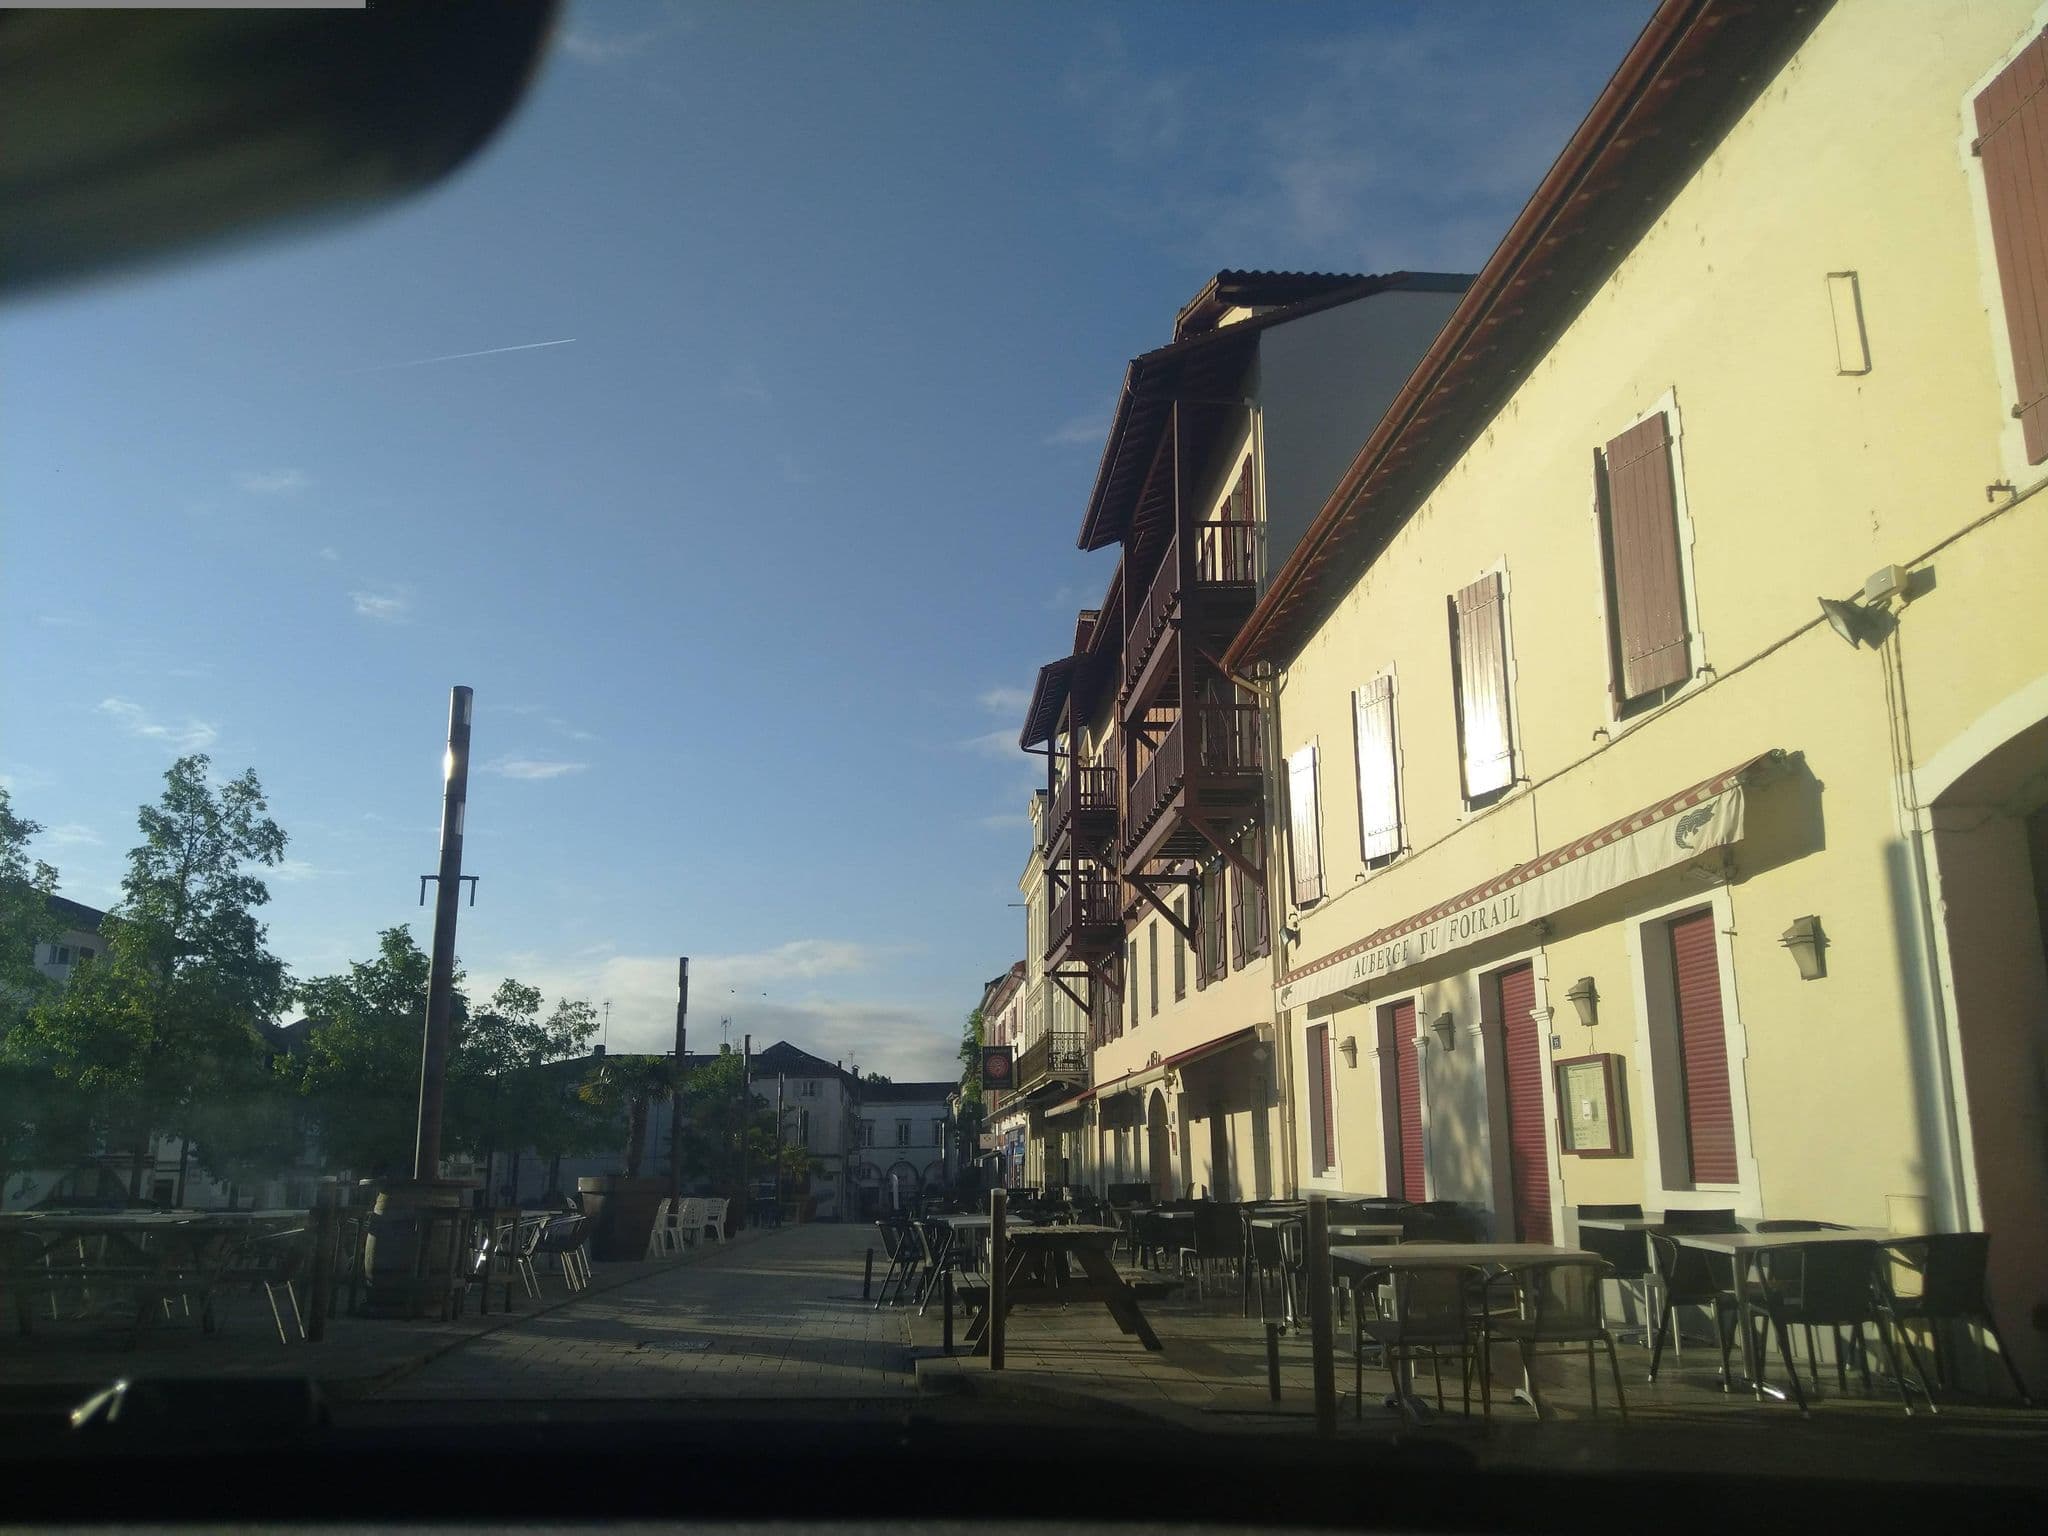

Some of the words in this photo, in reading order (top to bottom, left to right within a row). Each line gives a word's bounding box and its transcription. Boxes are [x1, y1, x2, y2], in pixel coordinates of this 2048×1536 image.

[1353, 939, 1409, 979] AUBERGE
[1420, 926, 1439, 955] DU
[1449, 893, 1520, 942] FOIRAIL
